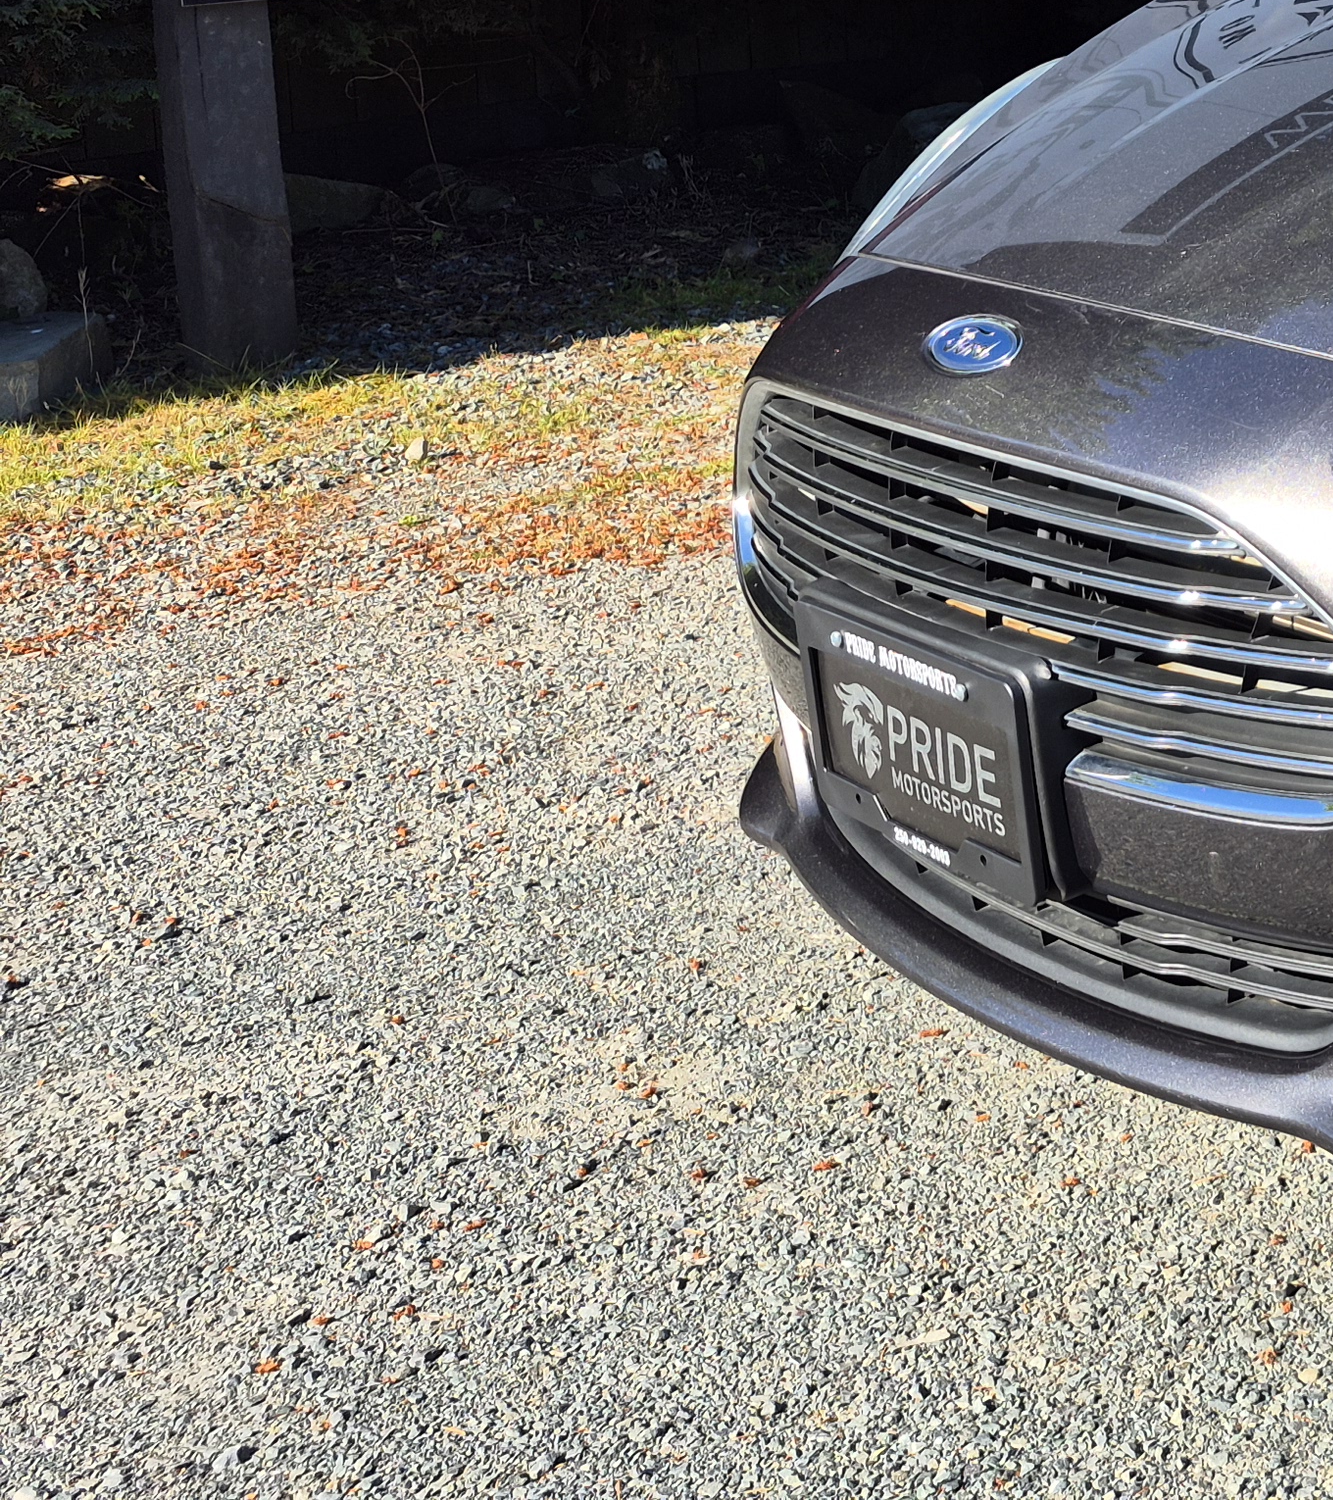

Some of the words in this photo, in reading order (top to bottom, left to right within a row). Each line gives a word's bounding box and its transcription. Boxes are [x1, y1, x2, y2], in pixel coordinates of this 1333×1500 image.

[943, 326, 1001, 361] Ford
[844, 631, 877, 664] PRIDE
[878, 645, 958, 699] MOTORSPORTS
[886, 704, 1001, 809] PRIDE
[891, 766, 1006, 837] MOTORSPORTS
